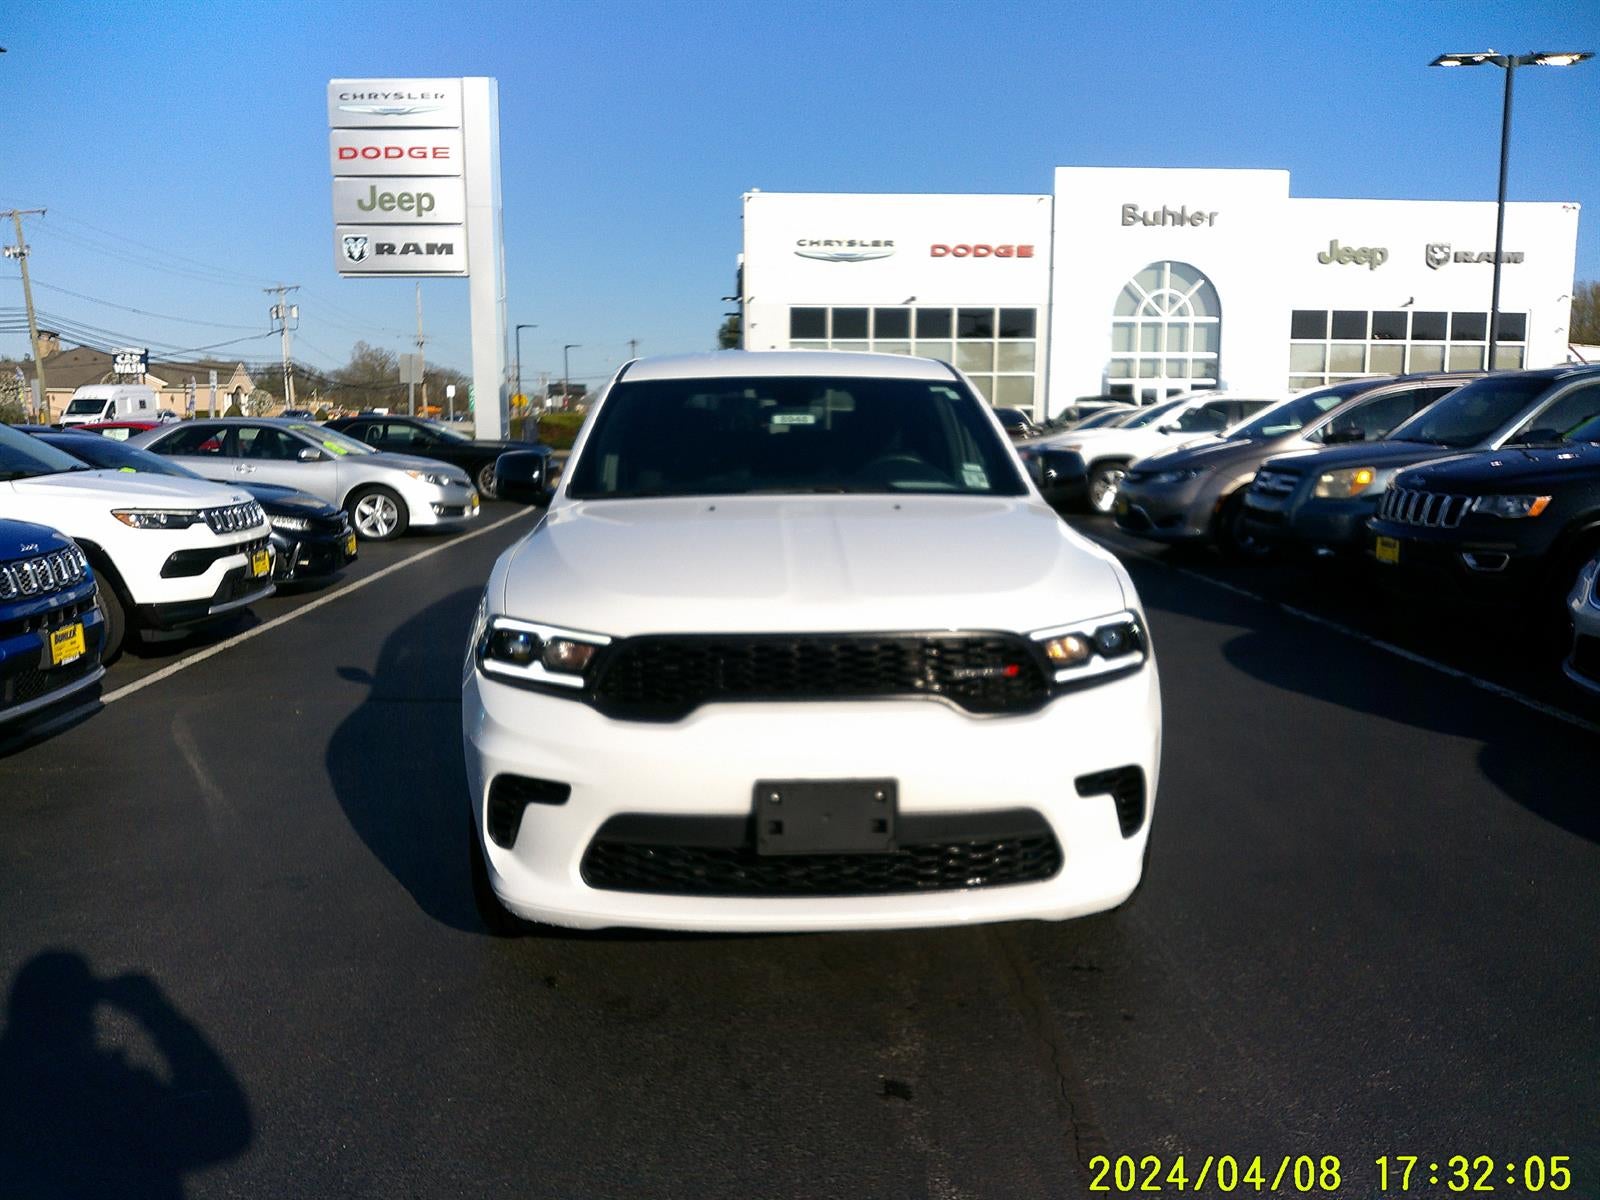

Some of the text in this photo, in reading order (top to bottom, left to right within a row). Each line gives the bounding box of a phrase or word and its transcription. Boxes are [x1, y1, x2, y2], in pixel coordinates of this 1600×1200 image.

[339, 92, 445, 100] CHRYSLER
[338, 147, 450, 159] DODGE
[358, 185, 435, 217] Jeep
[1121, 203, 1219, 226] Buhler
[375, 243, 454, 255] RAM
[796, 239, 894, 247] CHRYSLER
[931, 244, 1034, 257] DODGE
[1317, 239, 1388, 270] Jeep
